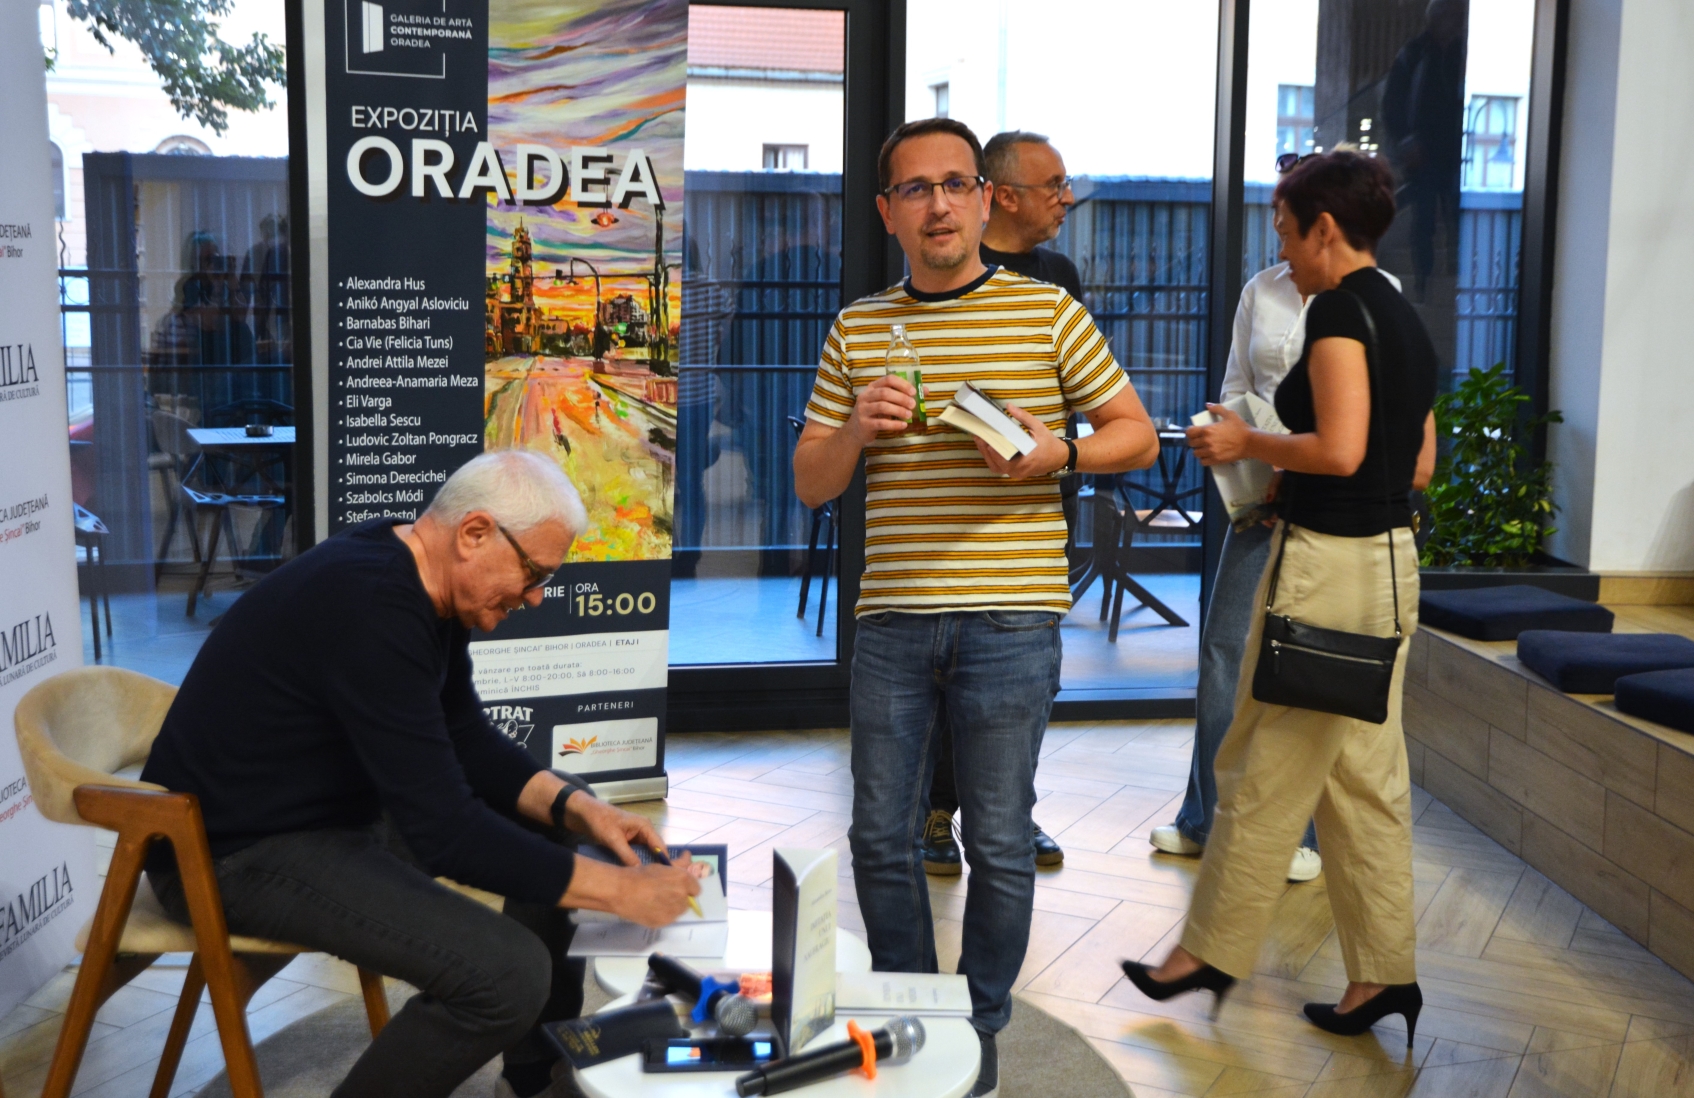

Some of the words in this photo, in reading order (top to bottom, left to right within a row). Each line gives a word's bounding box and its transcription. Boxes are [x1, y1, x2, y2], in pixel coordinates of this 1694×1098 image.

[390, 13, 431, 25] GALERIA
[433, 16, 446, 26] DE
[390, 25, 472, 40] CONTEMPORANĂ
[390, 37, 431, 48] ORADEA
[351, 105, 478, 137] EXPOZIȚIA
[347, 136, 663, 207] ORADEA
[346, 276, 401, 290] Alexandra
[404, 277, 425, 290] Hus
[346, 296, 378, 310] Anikó
[380, 297, 419, 313] Angyal
[421, 297, 469, 310] Asloviciu
[347, 316, 396, 329] Barnabas
[400, 316, 430, 329] Bihari
[346, 336, 363, 349] Cia
[365, 336, 382, 349] Vie
[385, 336, 422, 350] (Felicia
[424, 336, 453, 350] Tuns)
[346, 355, 383, 369] Andrei
[385, 355, 414, 368] Attila
[417, 355, 449, 368] Mezei
[346, 375, 448, 388] Andreea-Anamaria
[450, 375, 479, 387] Meza
[346, 395, 358, 408] Eli
[360, 395, 392, 410] Varga
[346, 413, 387, 427] Isabella
[390, 413, 421, 426] Sescu
[346, 433, 389, 447] Ludovic
[391, 432, 427, 446] Zoltan
[429, 432, 478, 447] Pongracz
[346, 453, 380, 466] Mirela
[383, 452, 416, 465] Gabor
[346, 472, 387, 485] Simona
[390, 470, 446, 483] Derecichei
[346, 491, 393, 504] Szabolcs
[396, 489, 423, 502] Módi
[25, 520, 41, 534] Bihor
[575, 582, 599, 593] ORA
[575, 592, 656, 617] 15:00
[0, 610, 56, 672] MILIA
[545, 643, 569, 652] BIHOR
[575, 640, 607, 649] ORADEA
[511, 684, 540, 692] ÎNCHIS
[577, 701, 634, 713] PARTENERI
[591, 740, 620, 748] BIBLIOTECA
[0, 776, 27, 803] IOTECA
